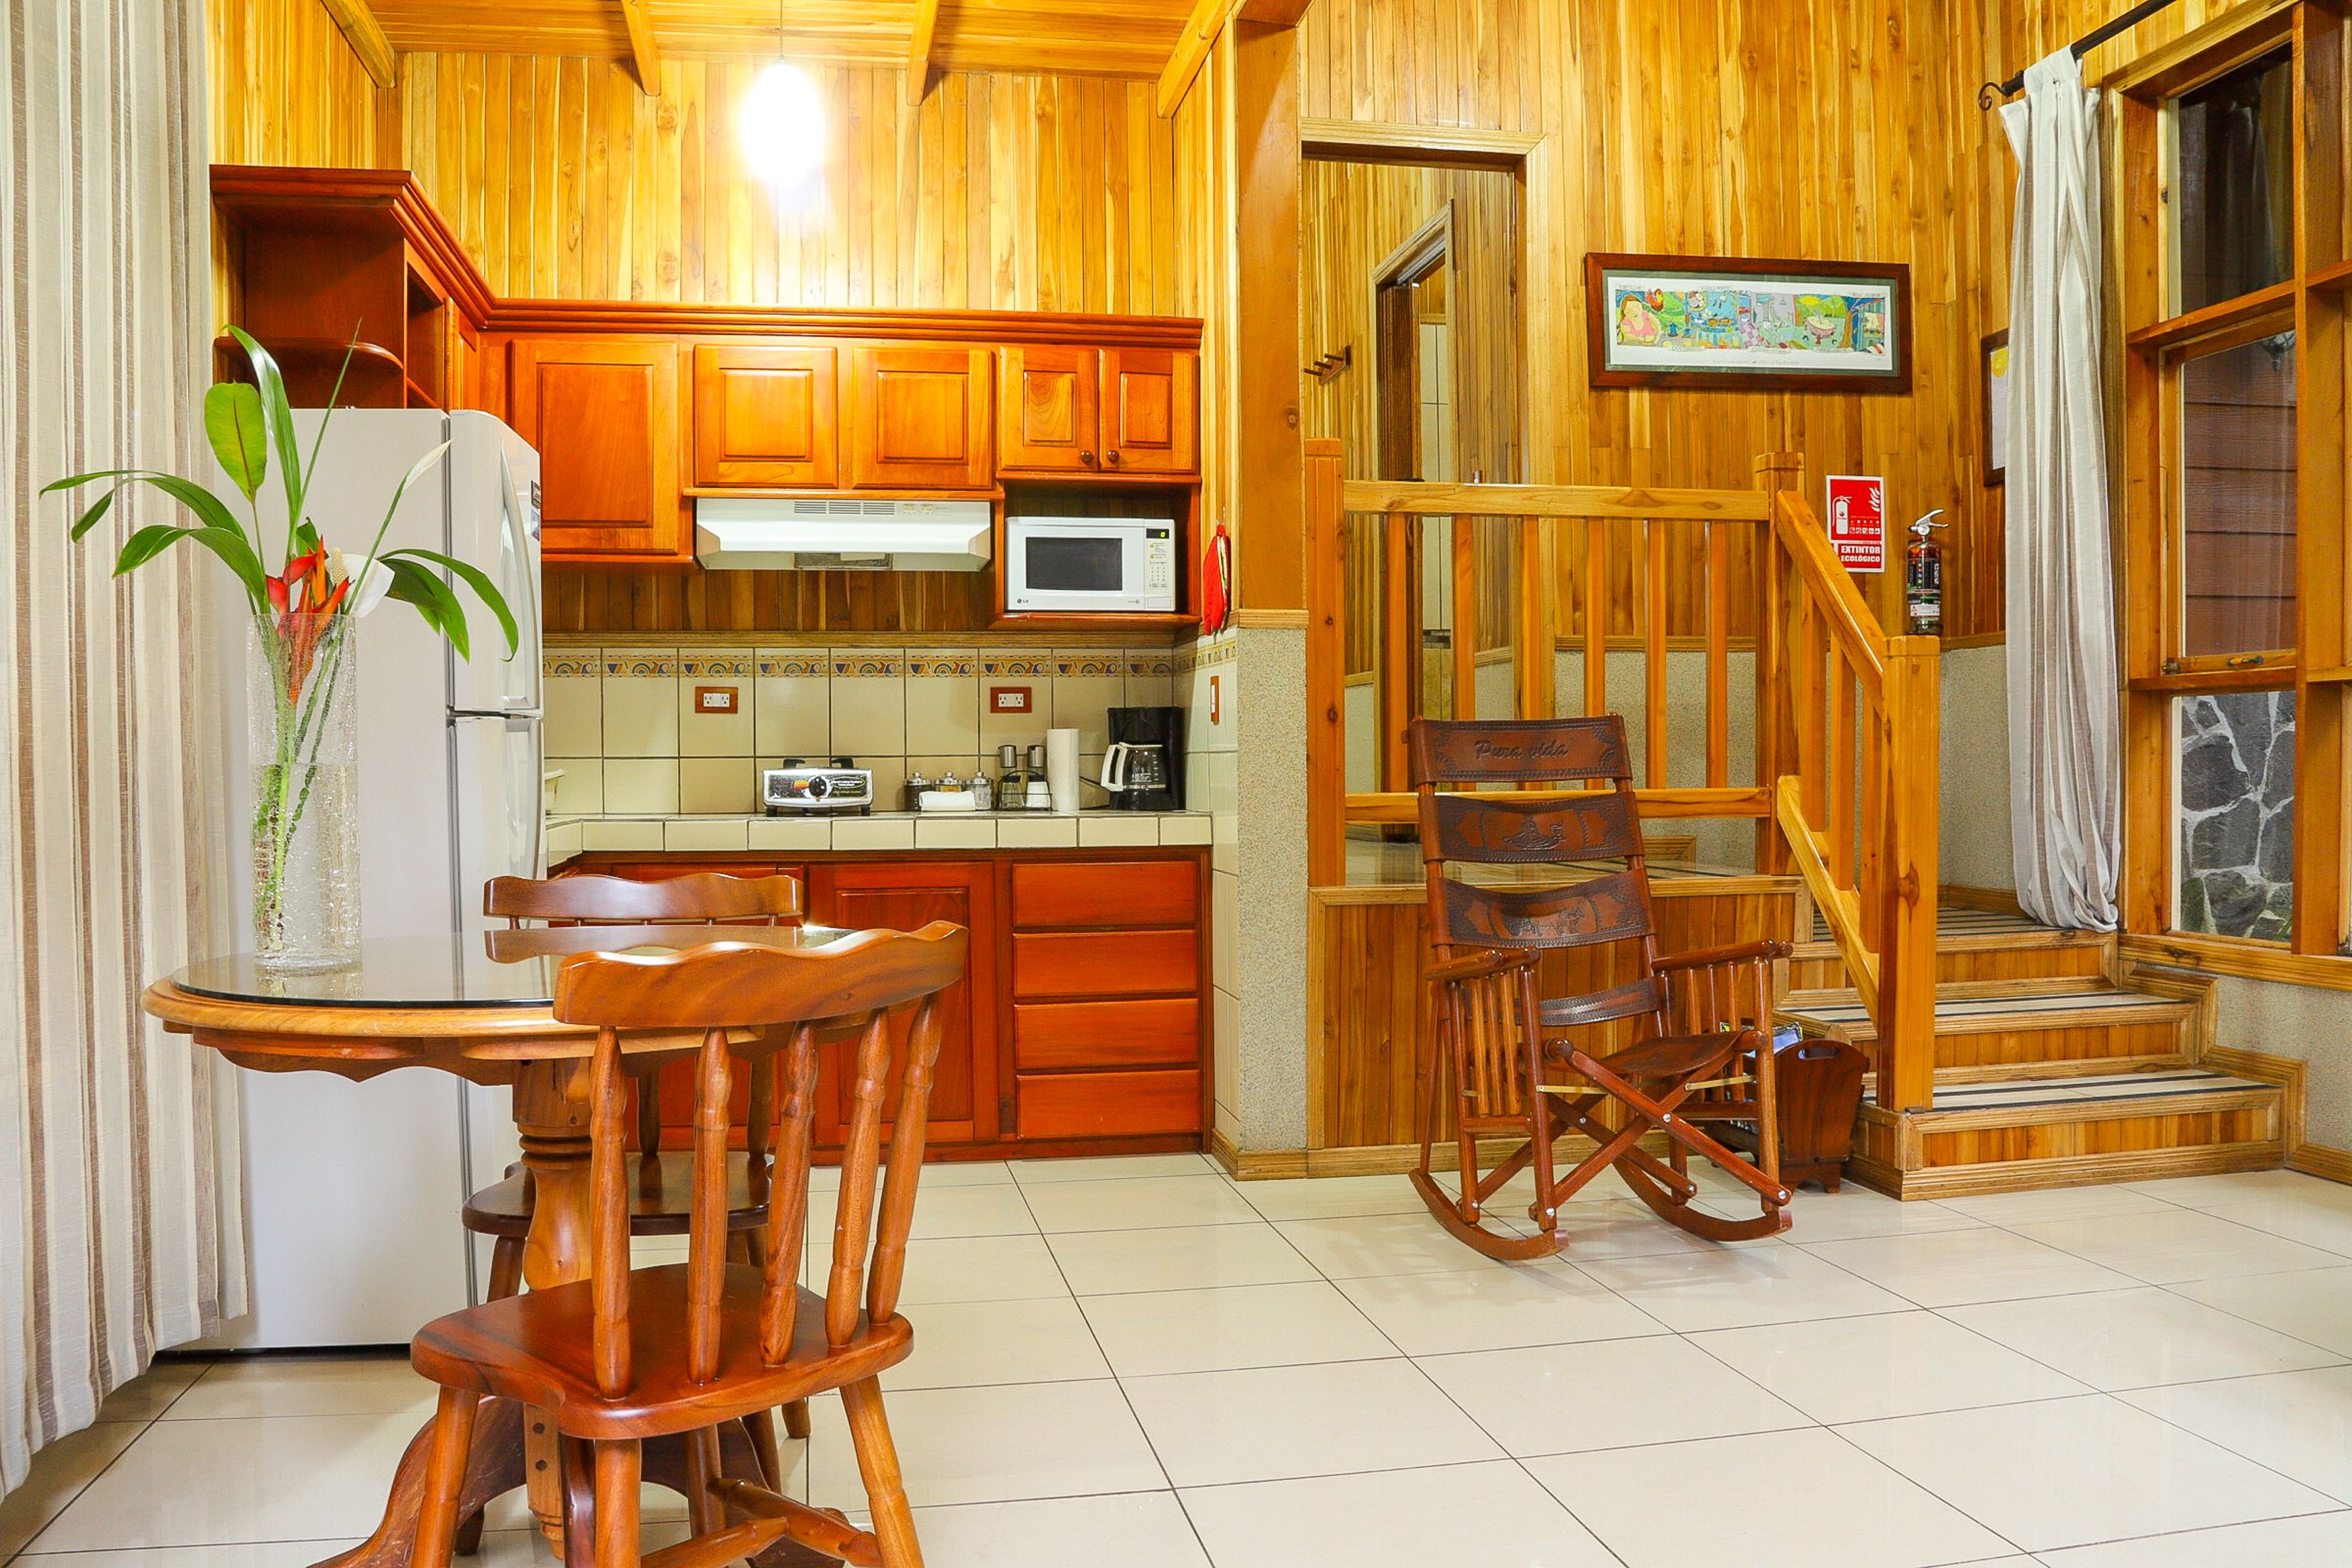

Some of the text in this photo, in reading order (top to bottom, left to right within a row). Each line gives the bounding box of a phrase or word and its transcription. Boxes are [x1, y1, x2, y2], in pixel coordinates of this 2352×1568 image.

[1841, 546, 1880, 554] EXTINTOR
[1474, 738, 1569, 760] Pura vida
